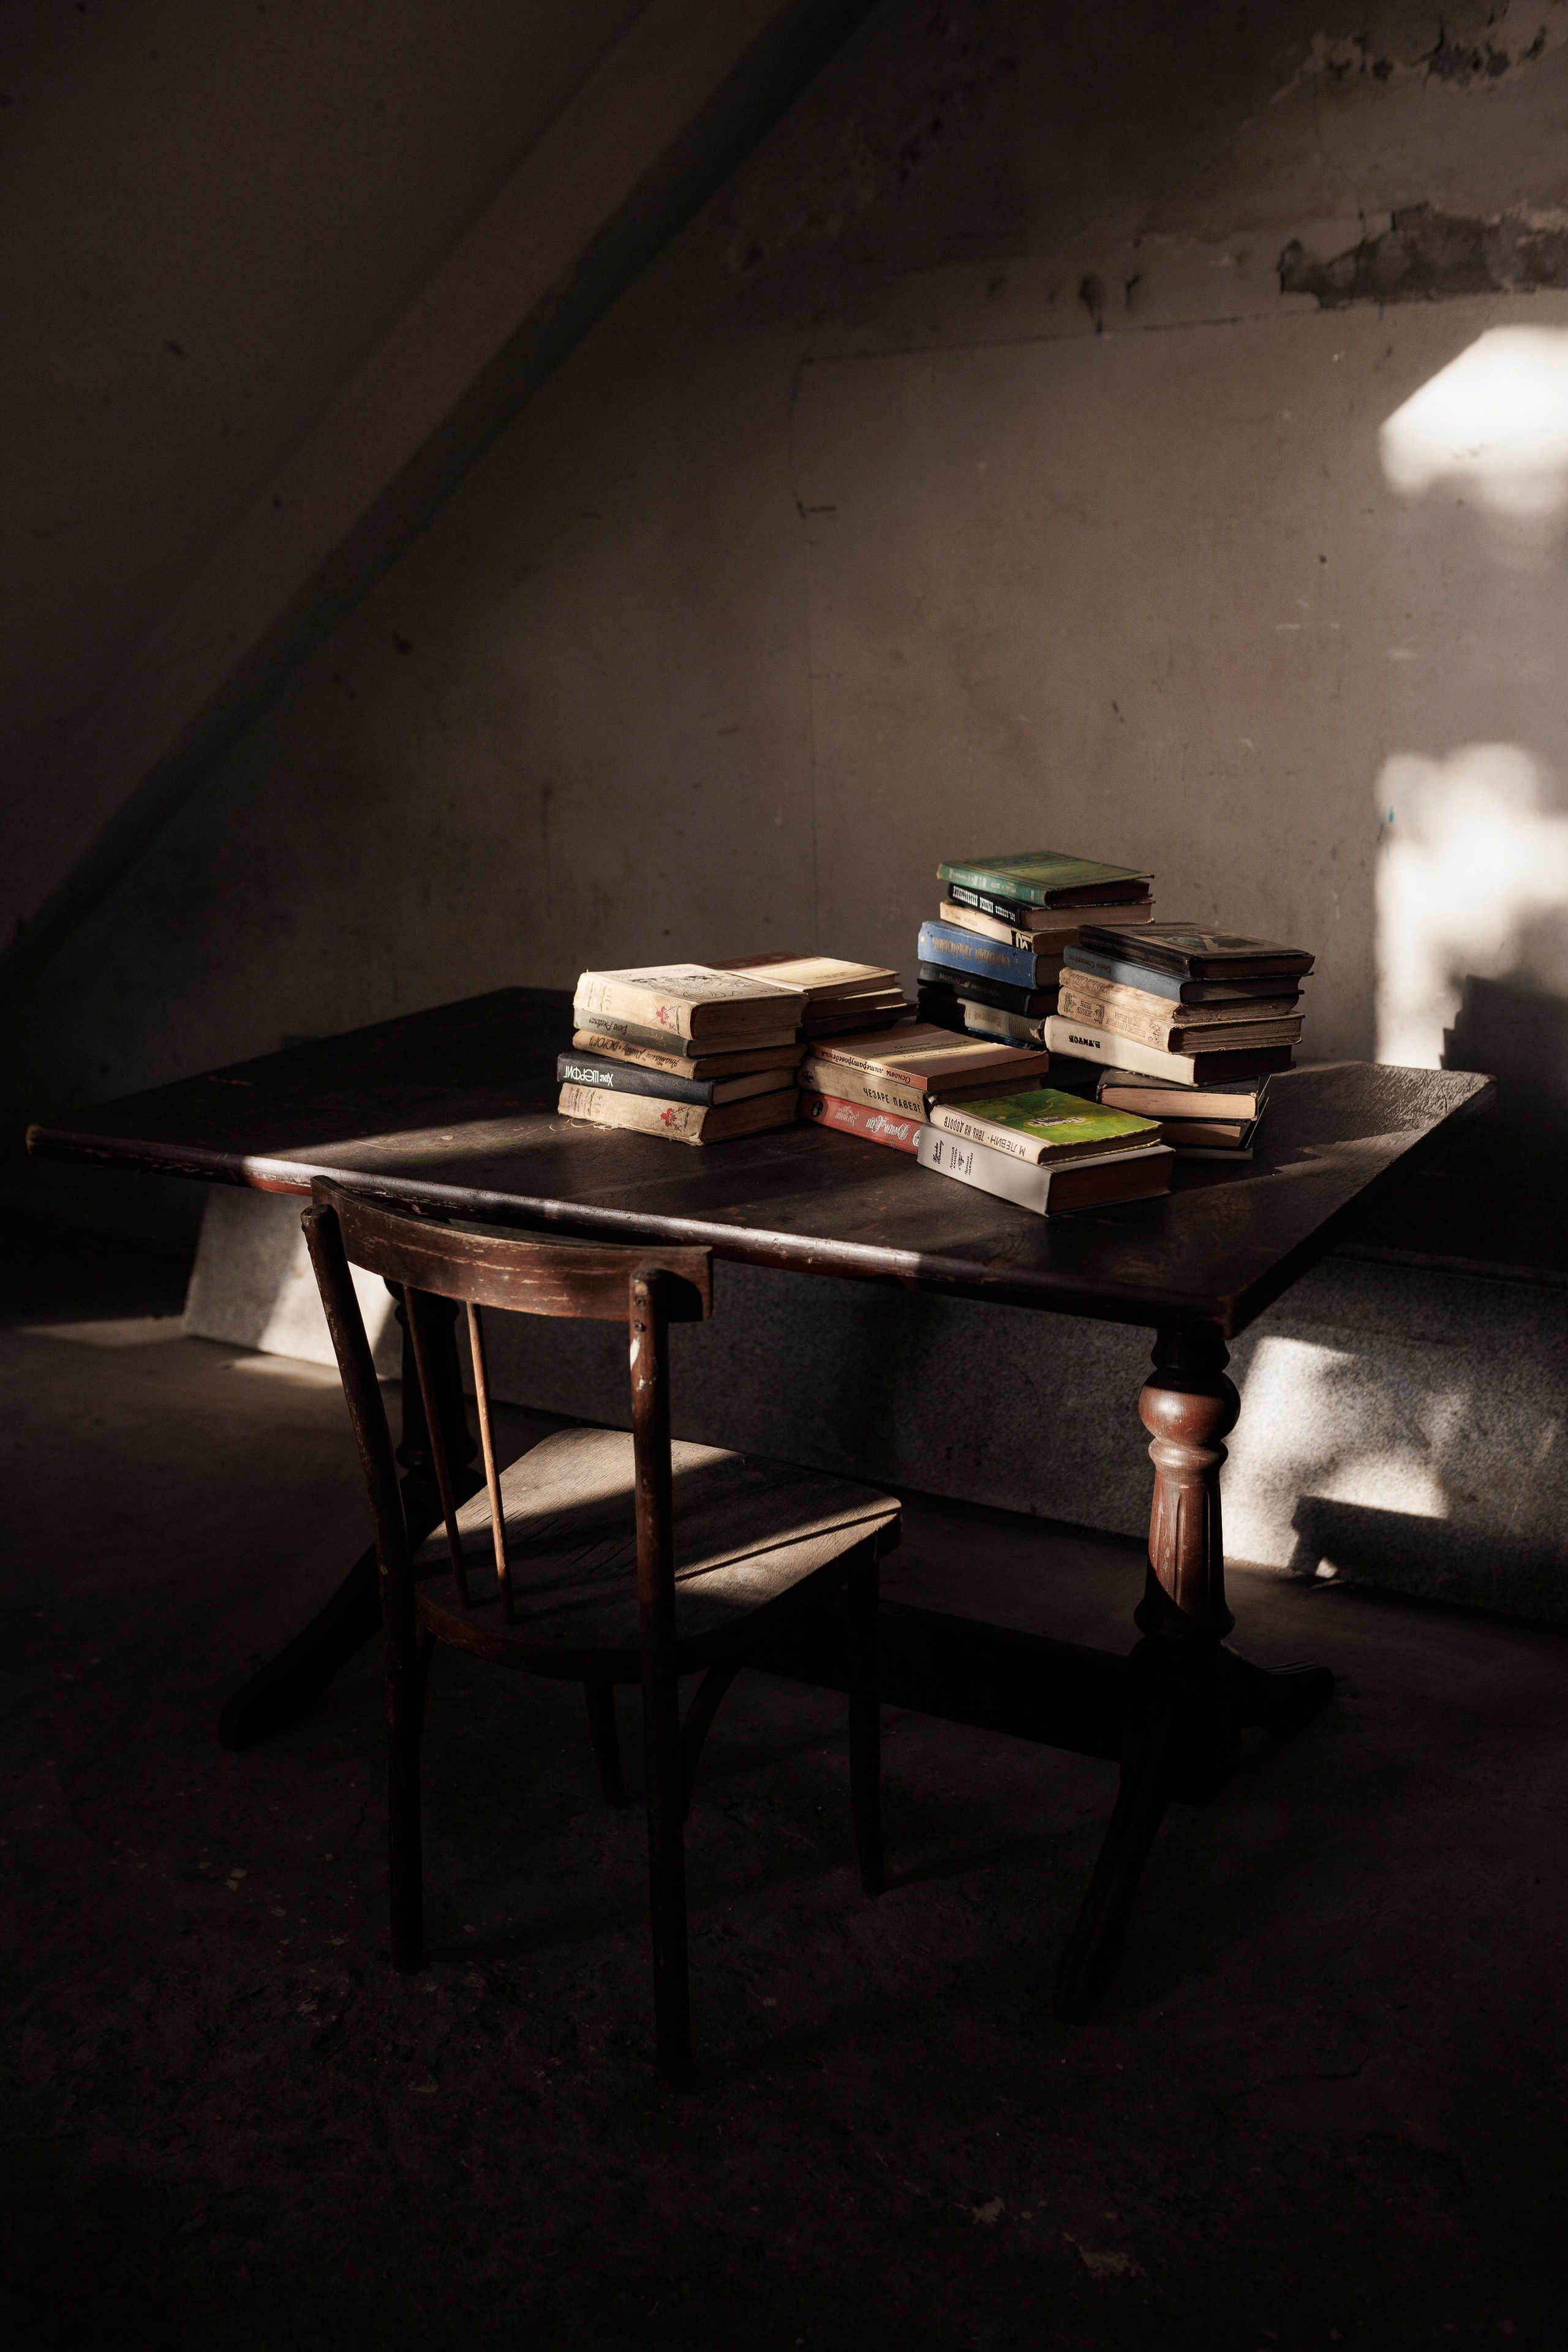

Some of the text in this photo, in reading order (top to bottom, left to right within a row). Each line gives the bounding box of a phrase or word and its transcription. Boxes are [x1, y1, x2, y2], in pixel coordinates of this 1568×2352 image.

[1080, 1000, 1092, 1010] ВЕРН
[1077, 1006, 1093, 1017] ЖЮЛЬ
[614, 1023, 628, 1035] Елена
[821, 1050, 911, 1084] Основы литературоведения
[863, 1087, 922, 1114] ЧЕЗАРЕ ПАВЕЗЕ
[944, 1116, 964, 1133] дороге
[965, 1124, 972, 1136] на
[990, 1134, 1017, 1153] ЛЕВИН
[1019, 1146, 1027, 1157] М
